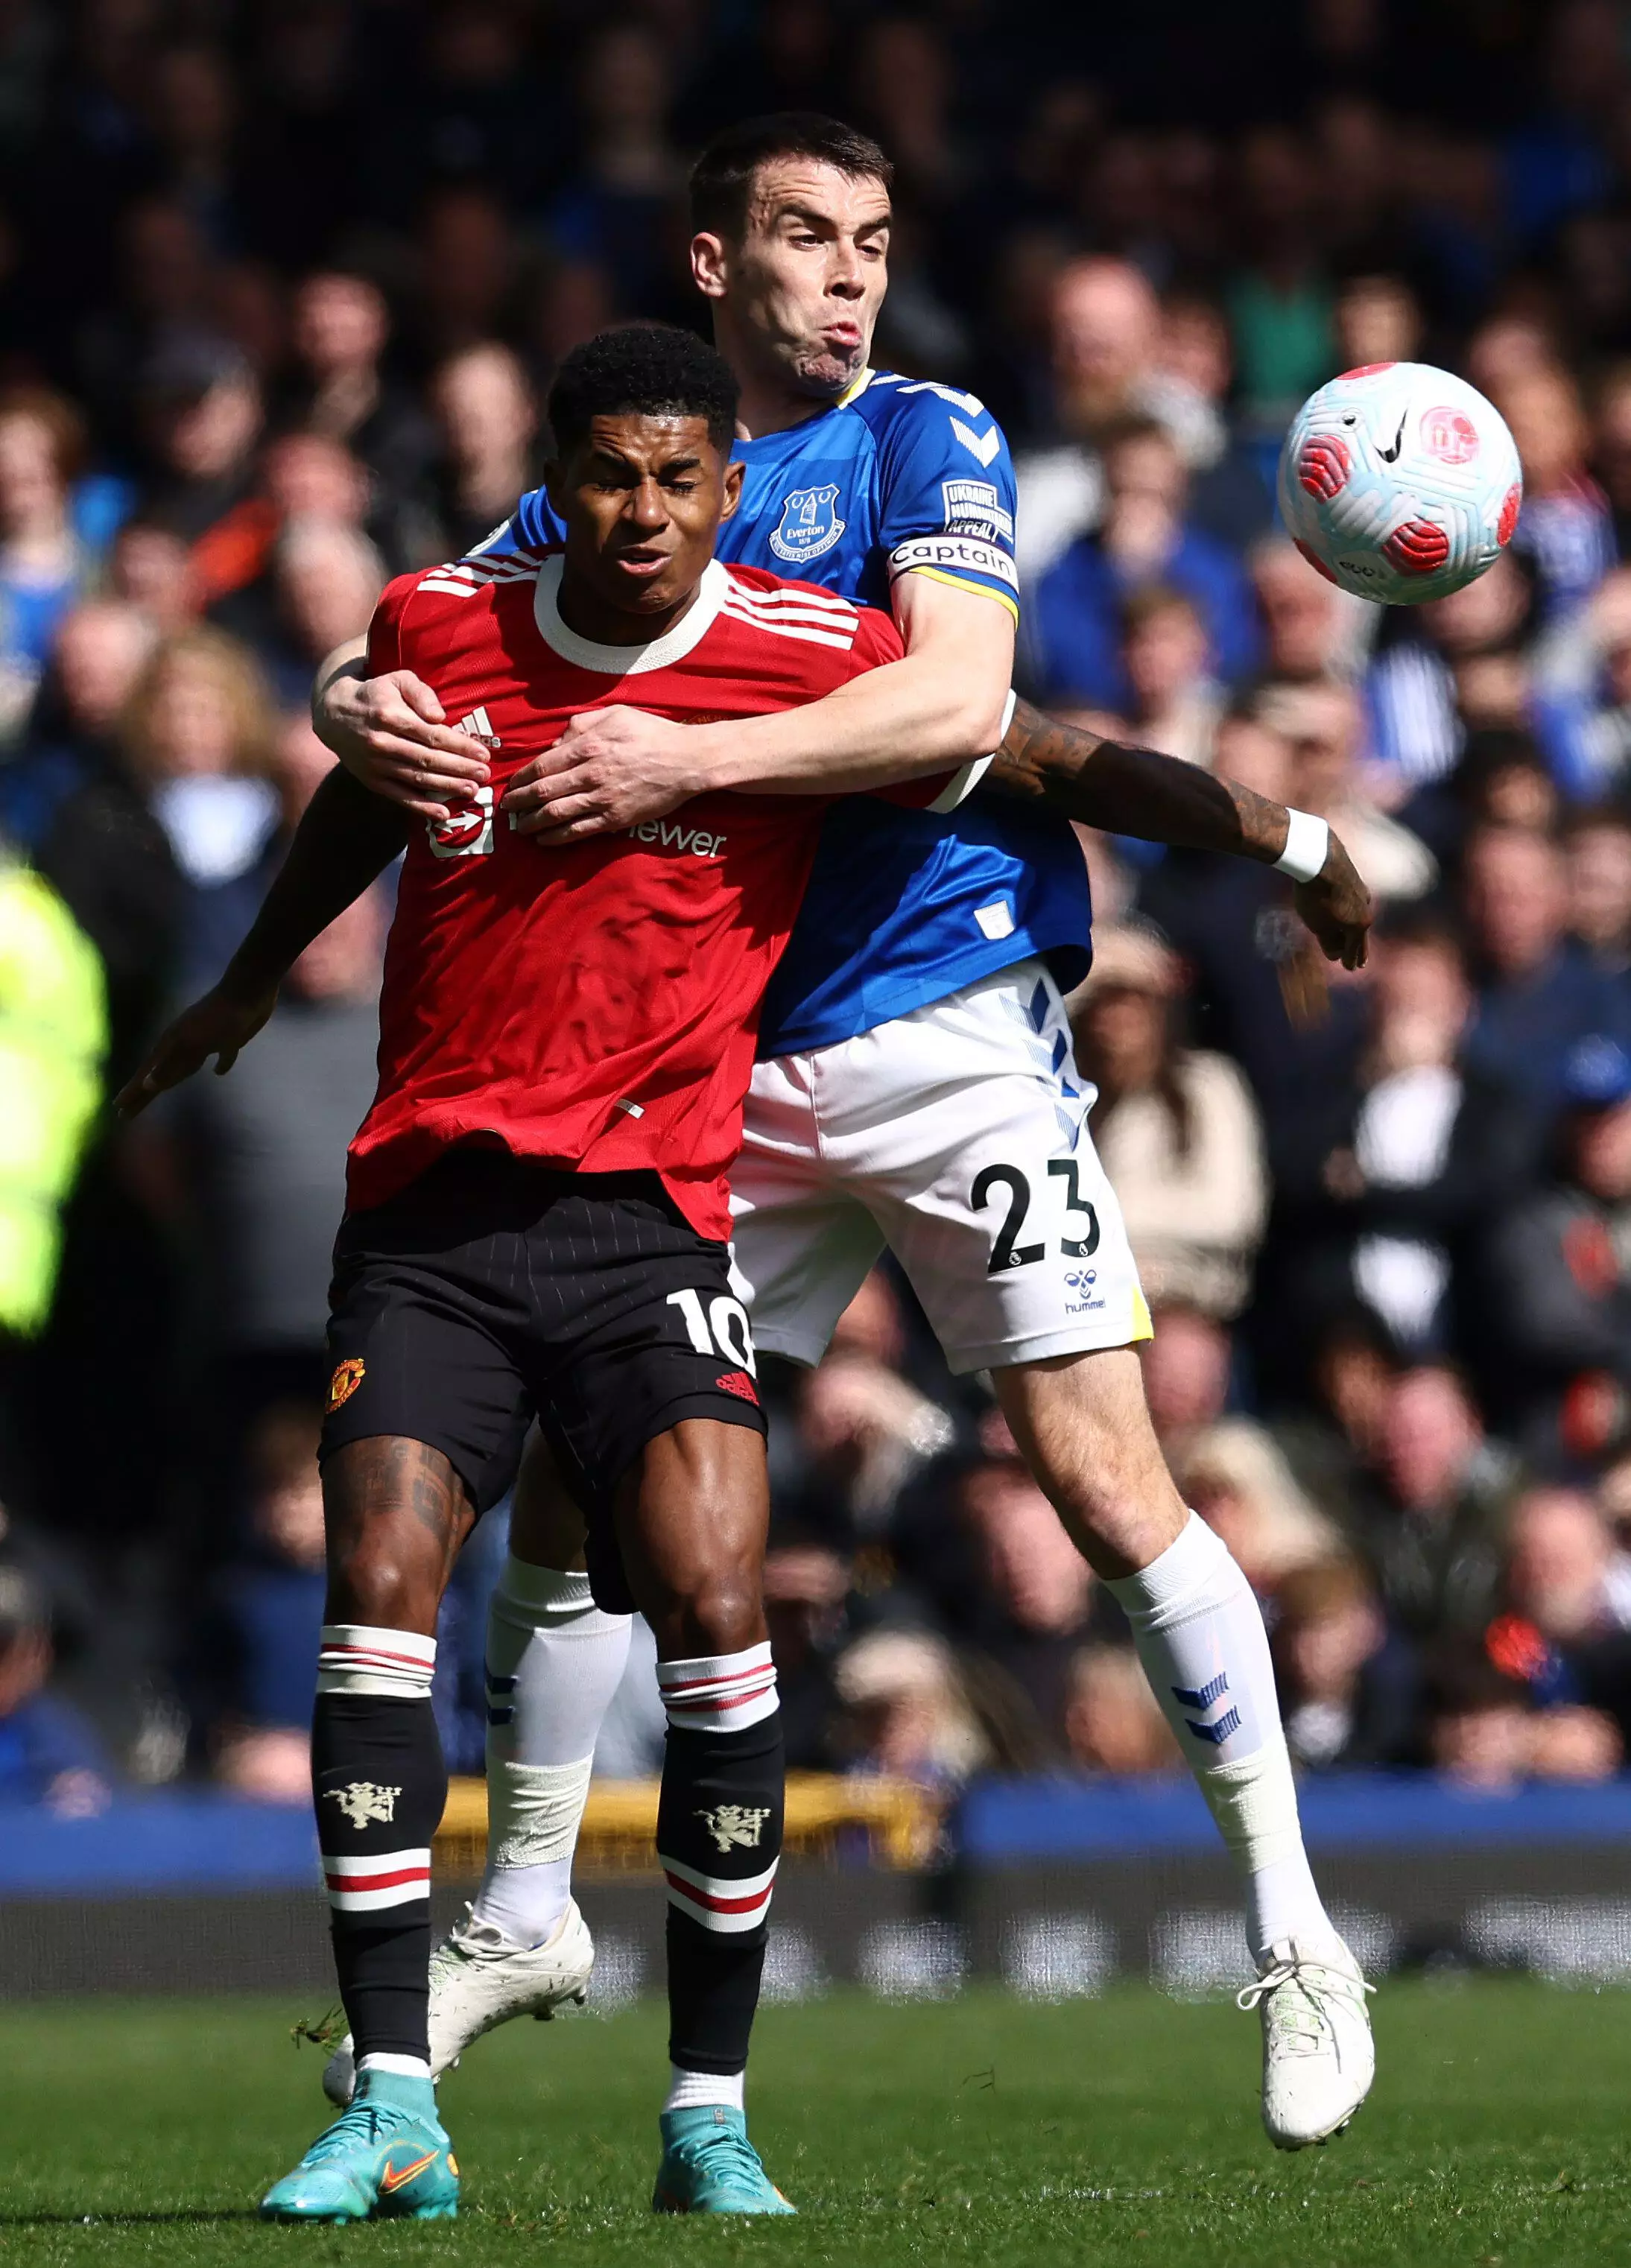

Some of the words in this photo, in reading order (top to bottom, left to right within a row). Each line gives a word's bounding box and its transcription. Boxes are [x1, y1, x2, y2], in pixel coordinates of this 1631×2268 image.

[948, 484, 994, 507] UKRAINE
[787, 525, 825, 539] Everton
[948, 519, 992, 540] APPEAL
[971, 1159, 1100, 1273] 23
[1065, 1298, 1106, 1314] hummel
[666, 1287, 757, 1379] 10
